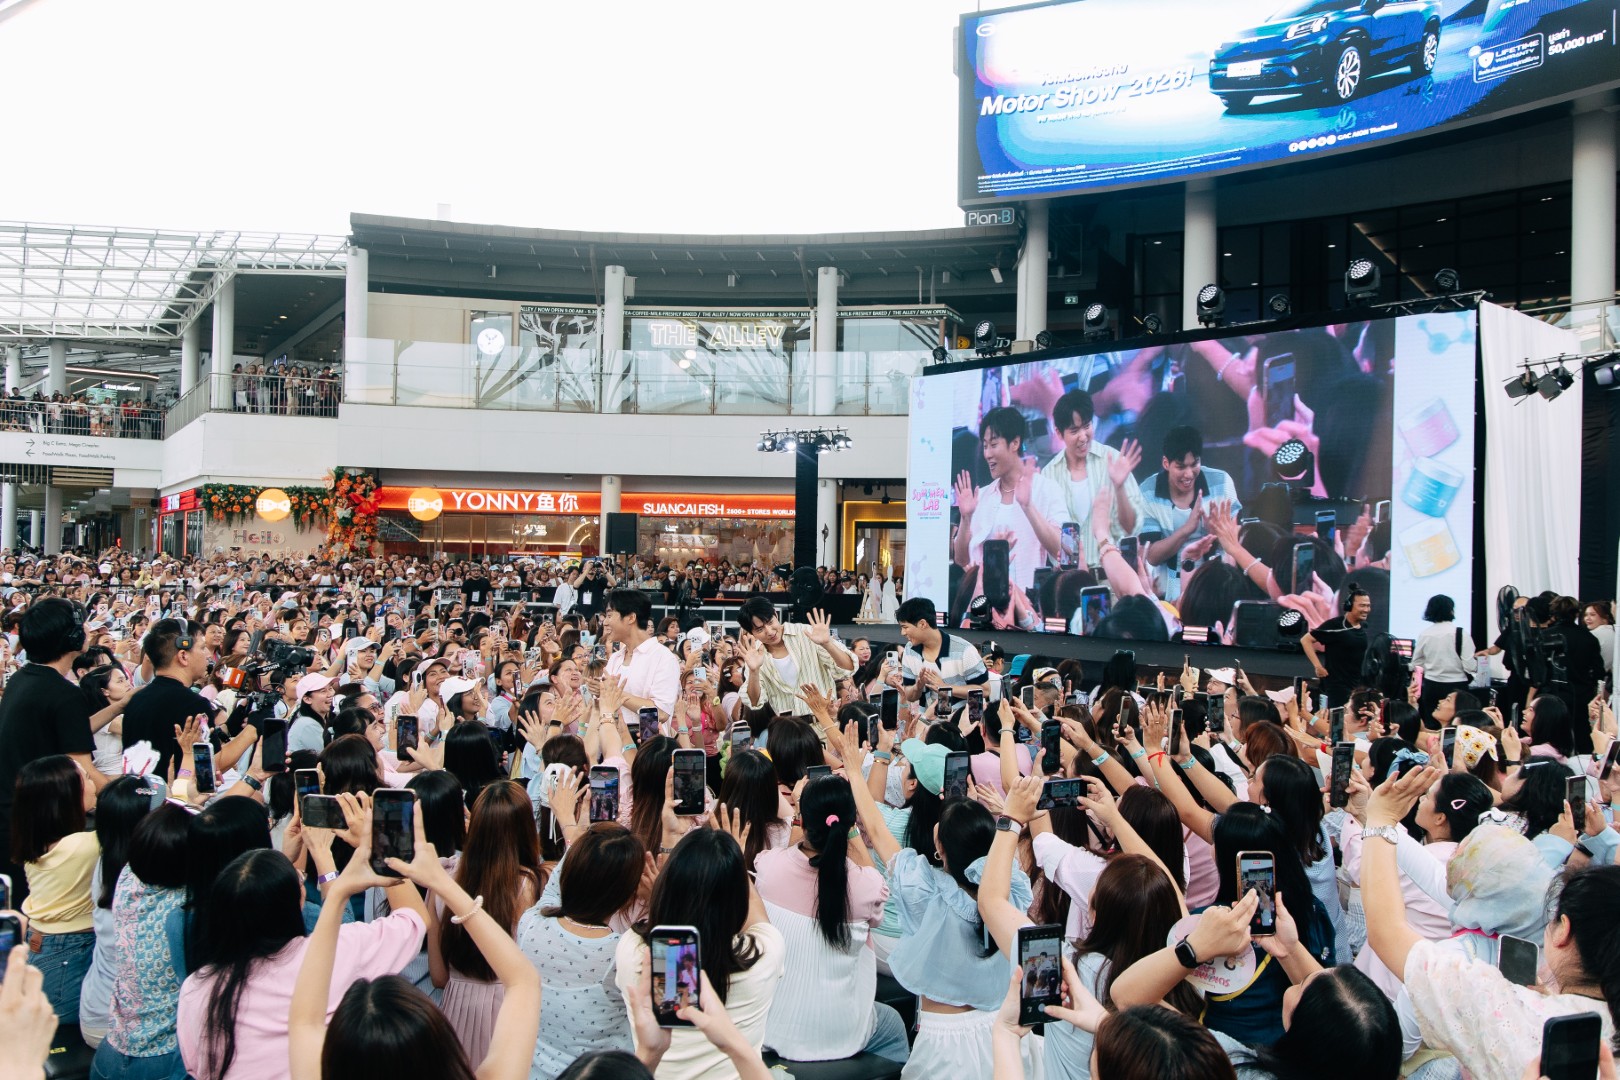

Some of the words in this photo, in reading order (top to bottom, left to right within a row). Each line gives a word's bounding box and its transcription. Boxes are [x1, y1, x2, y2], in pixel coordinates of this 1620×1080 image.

[1495, 40, 1540, 57] LIFETIME
[1548, 37, 1585, 55] 50,000
[1495, 48, 1535, 62] WARRANTY
[980, 92, 1050, 116] Motor
[1055, 84, 1120, 110] Show
[1129, 65, 1195, 98] 2026!
[1370, 122, 1398, 134] Thailand
[649, 323, 697, 346] THE
[708, 324, 784, 347] ALLEY
[451, 491, 534, 511] YONNY
[535, 492, 579, 513] 鱼你
[643, 502, 697, 515] SUANCAI
[698, 503, 724, 516] FISH
[747, 508, 771, 516] STORES
[923, 499, 939, 511] LAB
[233, 529, 286, 544] Hello
